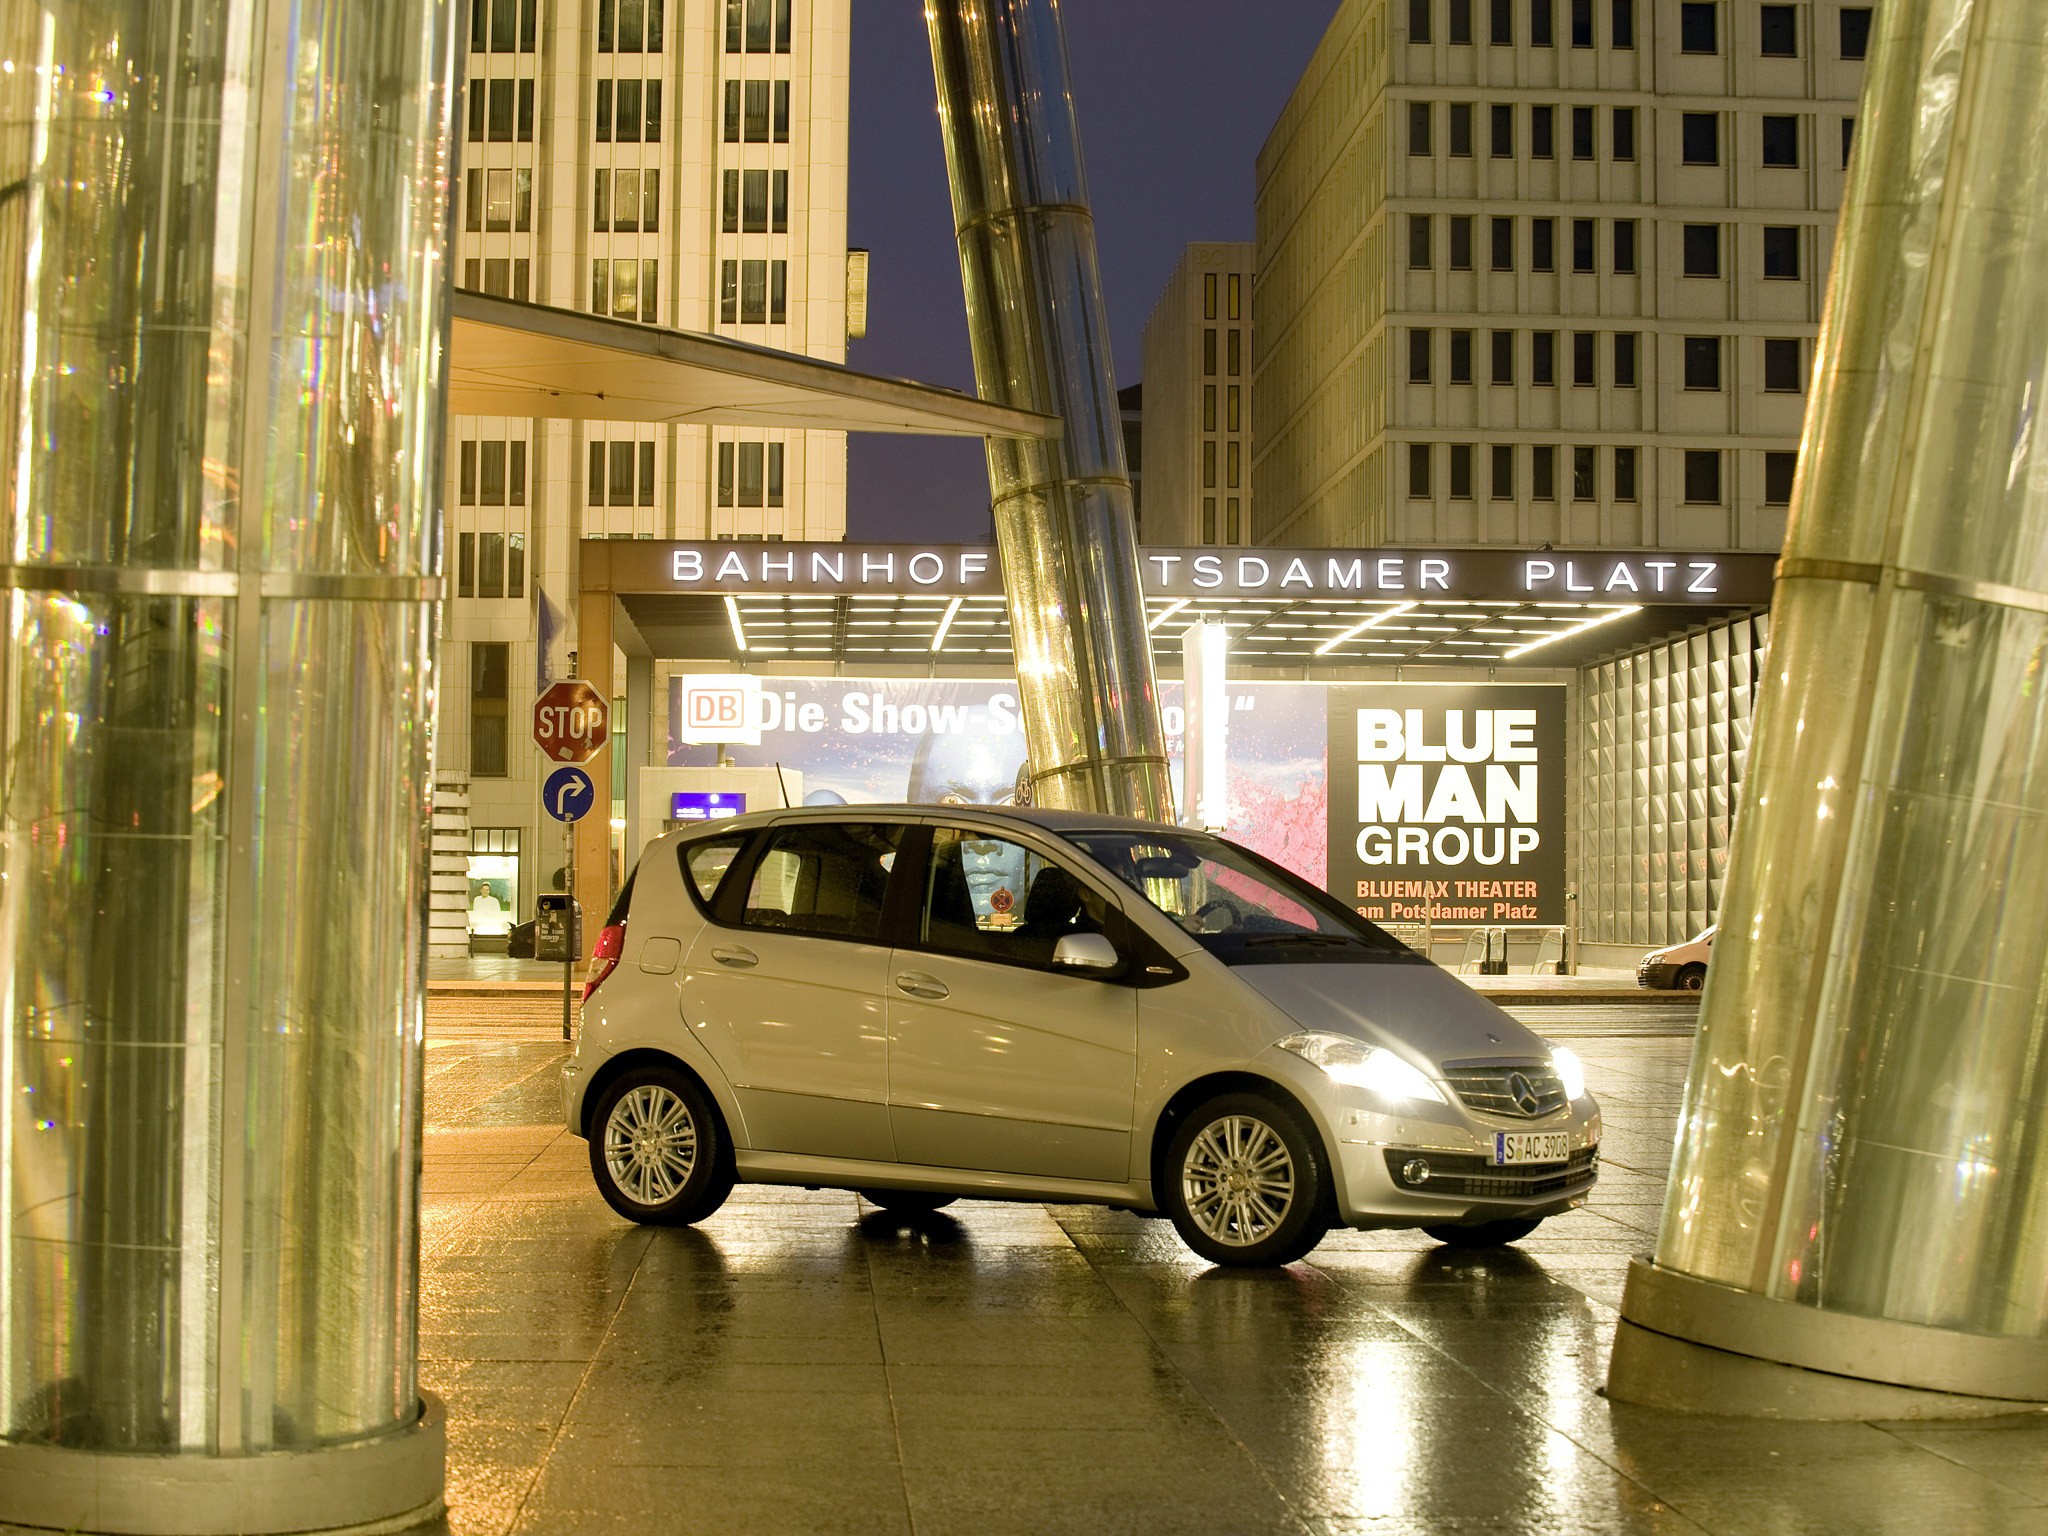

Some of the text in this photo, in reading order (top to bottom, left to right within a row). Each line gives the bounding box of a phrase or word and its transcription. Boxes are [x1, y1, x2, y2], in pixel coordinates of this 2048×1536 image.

[672, 550, 1718, 594] BAHNHOF TSDAMER PLATZ
[539, 706, 603, 739] STOP
[695, 695, 737, 721] DB
[1357, 708, 1538, 762] BLUE
[1358, 765, 1538, 823] MAN
[1356, 826, 1540, 866] GROUP
[1357, 880, 1537, 898] BLUEMAX THEATER
[1357, 906, 1384, 919] am
[1493, 902, 1537, 919] Platz
[1506, 1136, 1515, 1160] S
[1525, 1136, 1541, 1159] AC
